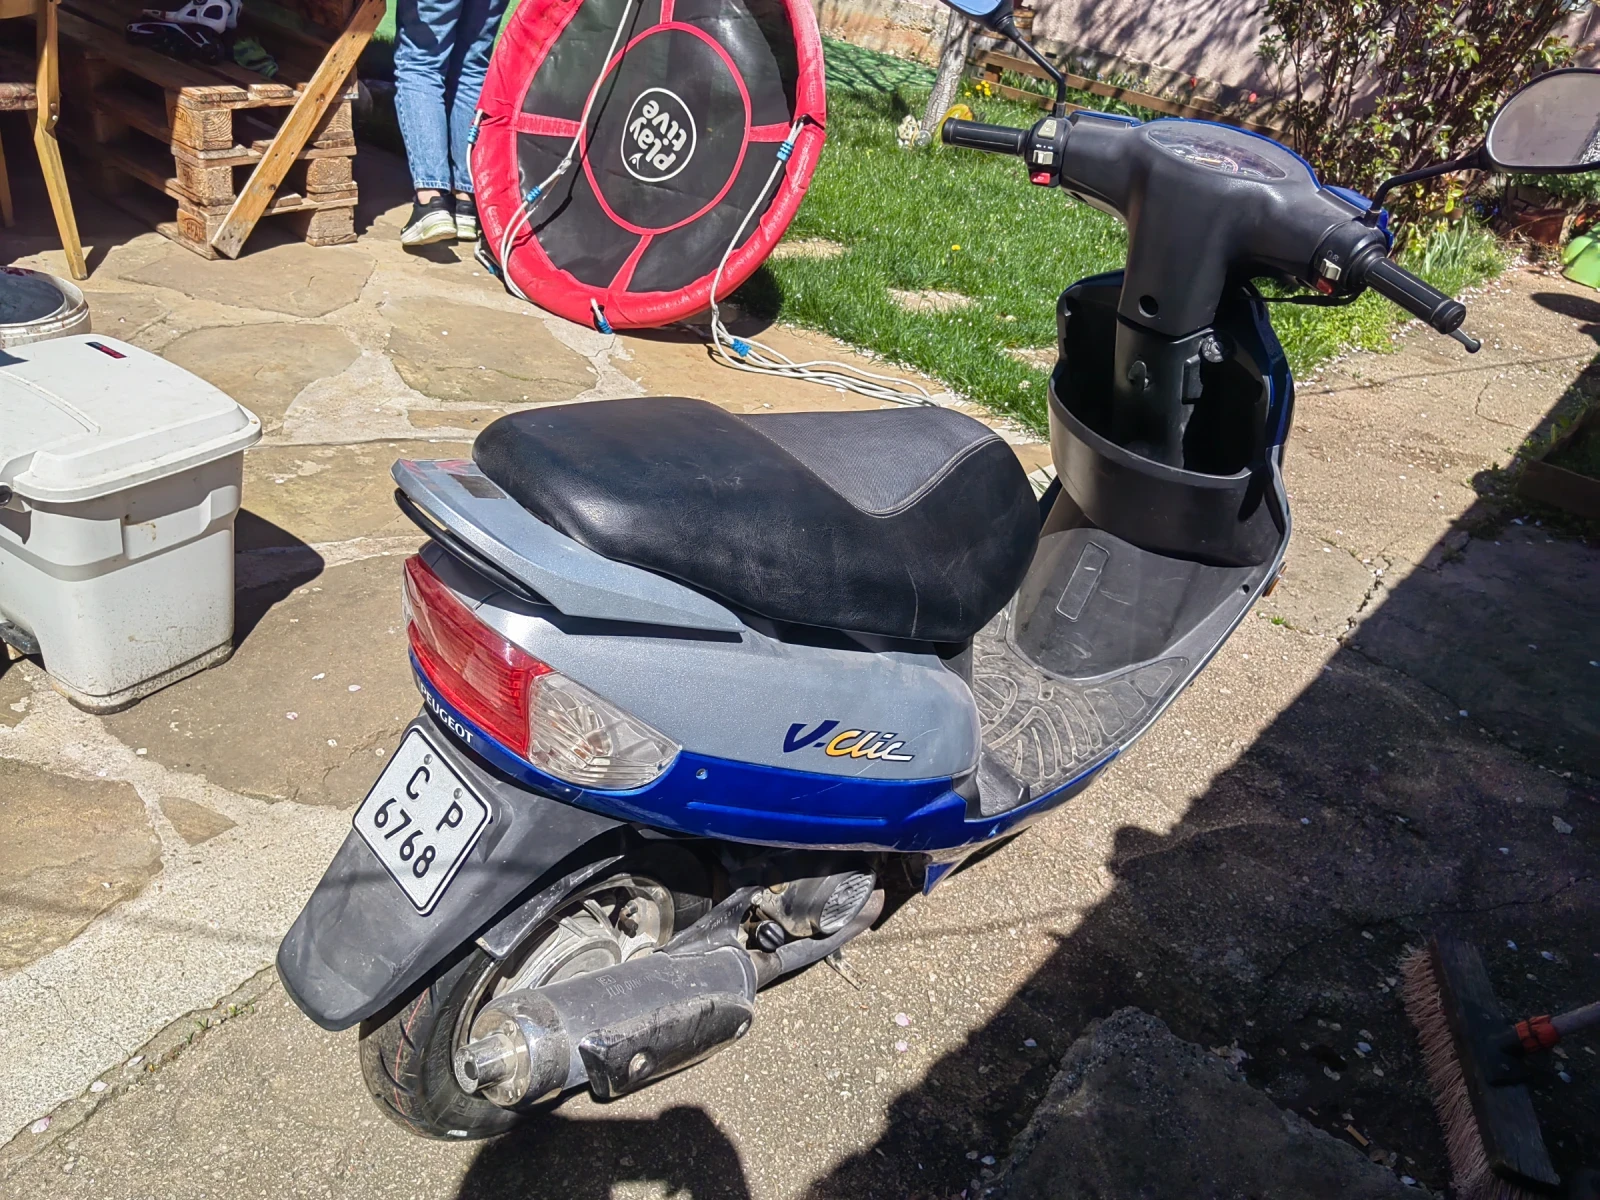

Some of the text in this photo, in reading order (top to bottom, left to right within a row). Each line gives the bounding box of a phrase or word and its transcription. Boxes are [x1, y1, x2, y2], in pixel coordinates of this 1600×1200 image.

[629, 116, 677, 171] Play
[642, 99, 688, 152] tive
[420, 682, 474, 744] PEUGEOT
[406, 765, 464, 832] C P
[373, 797, 437, 879] 6768
